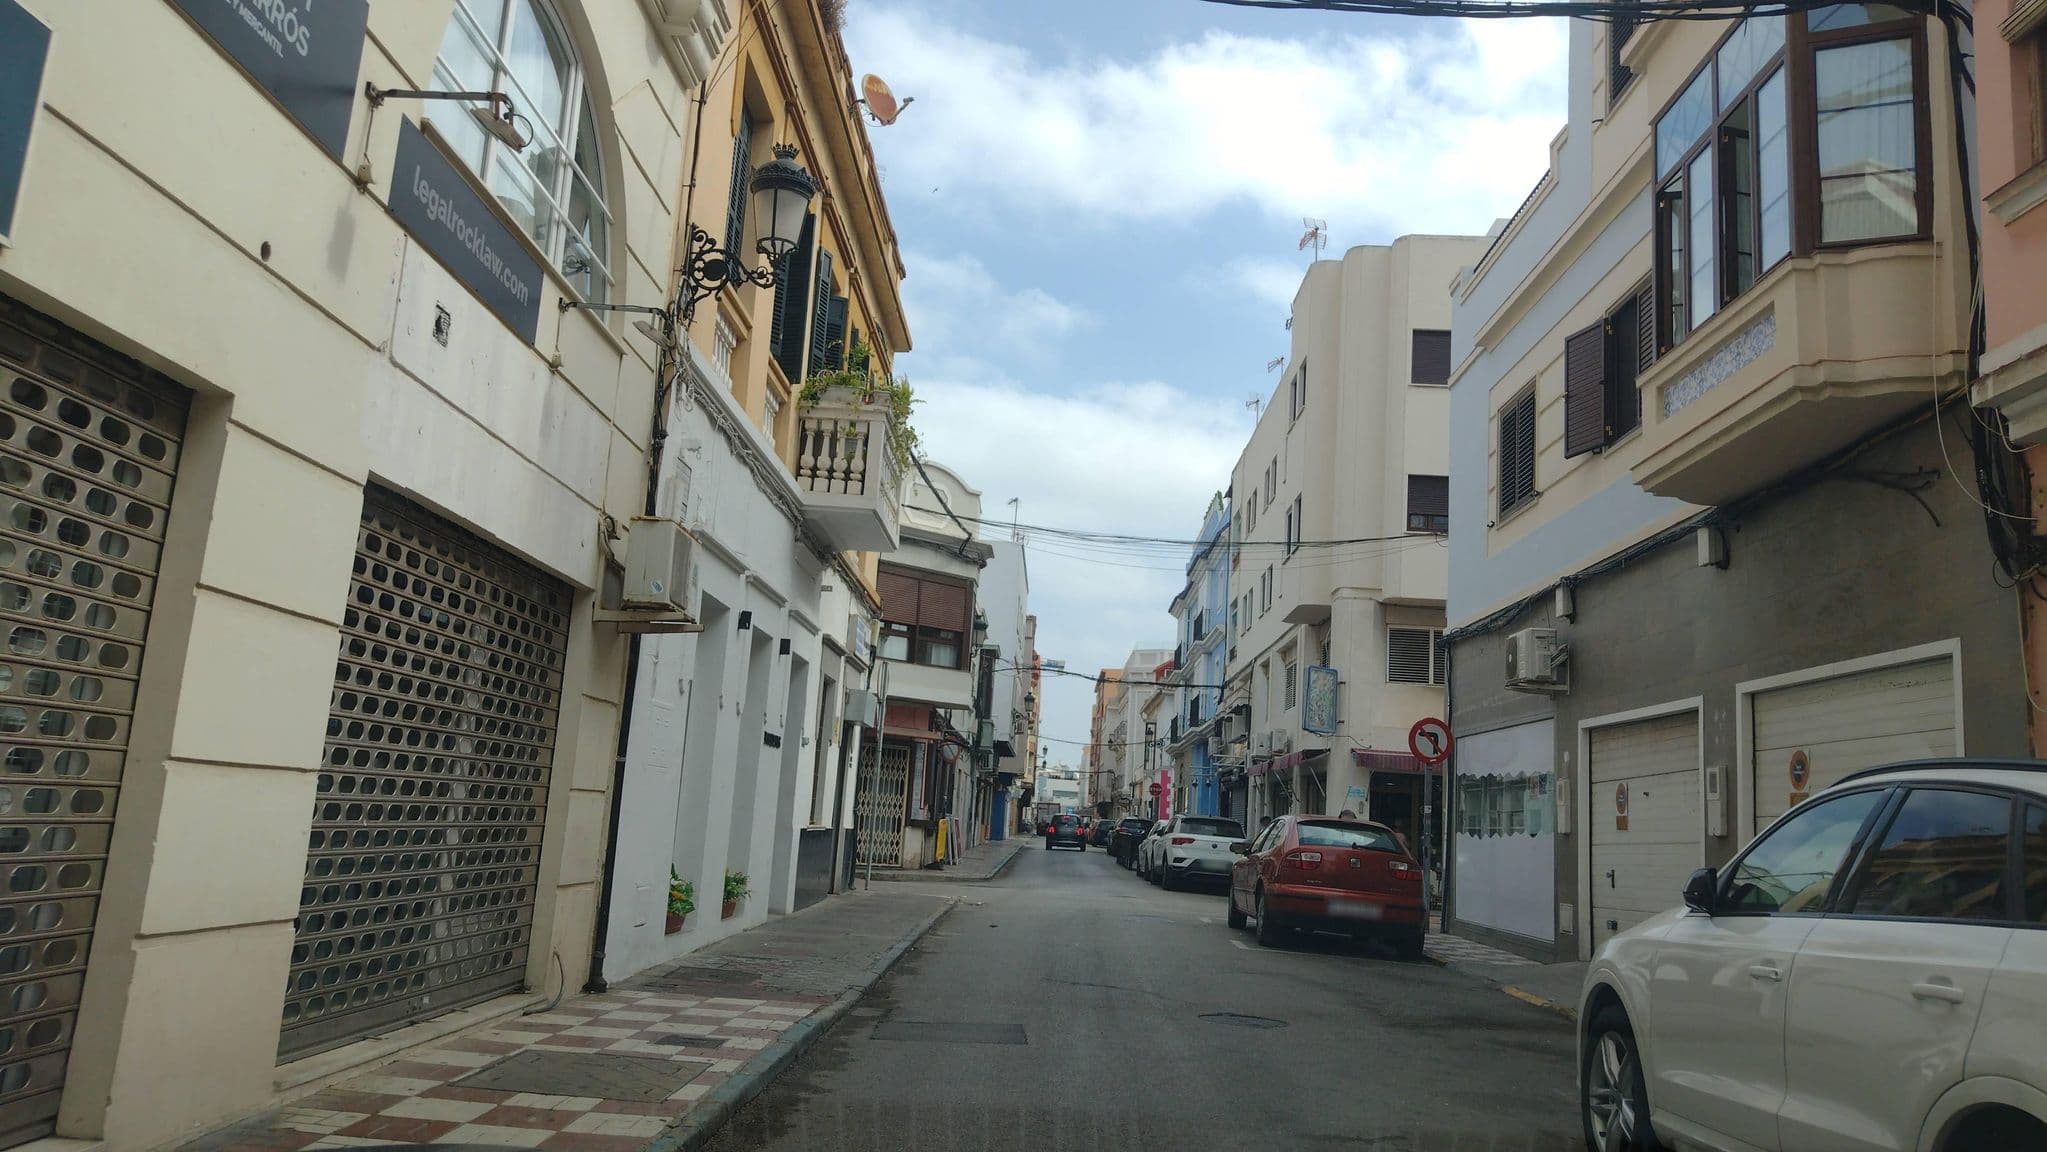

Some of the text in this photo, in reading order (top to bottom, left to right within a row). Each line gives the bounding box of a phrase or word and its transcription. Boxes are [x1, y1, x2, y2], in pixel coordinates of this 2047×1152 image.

[238, 3, 284, 58] MERCANTIL
[252, 0, 311, 57] RRÓS
[412, 164, 529, 307] legalrocklaw.com
